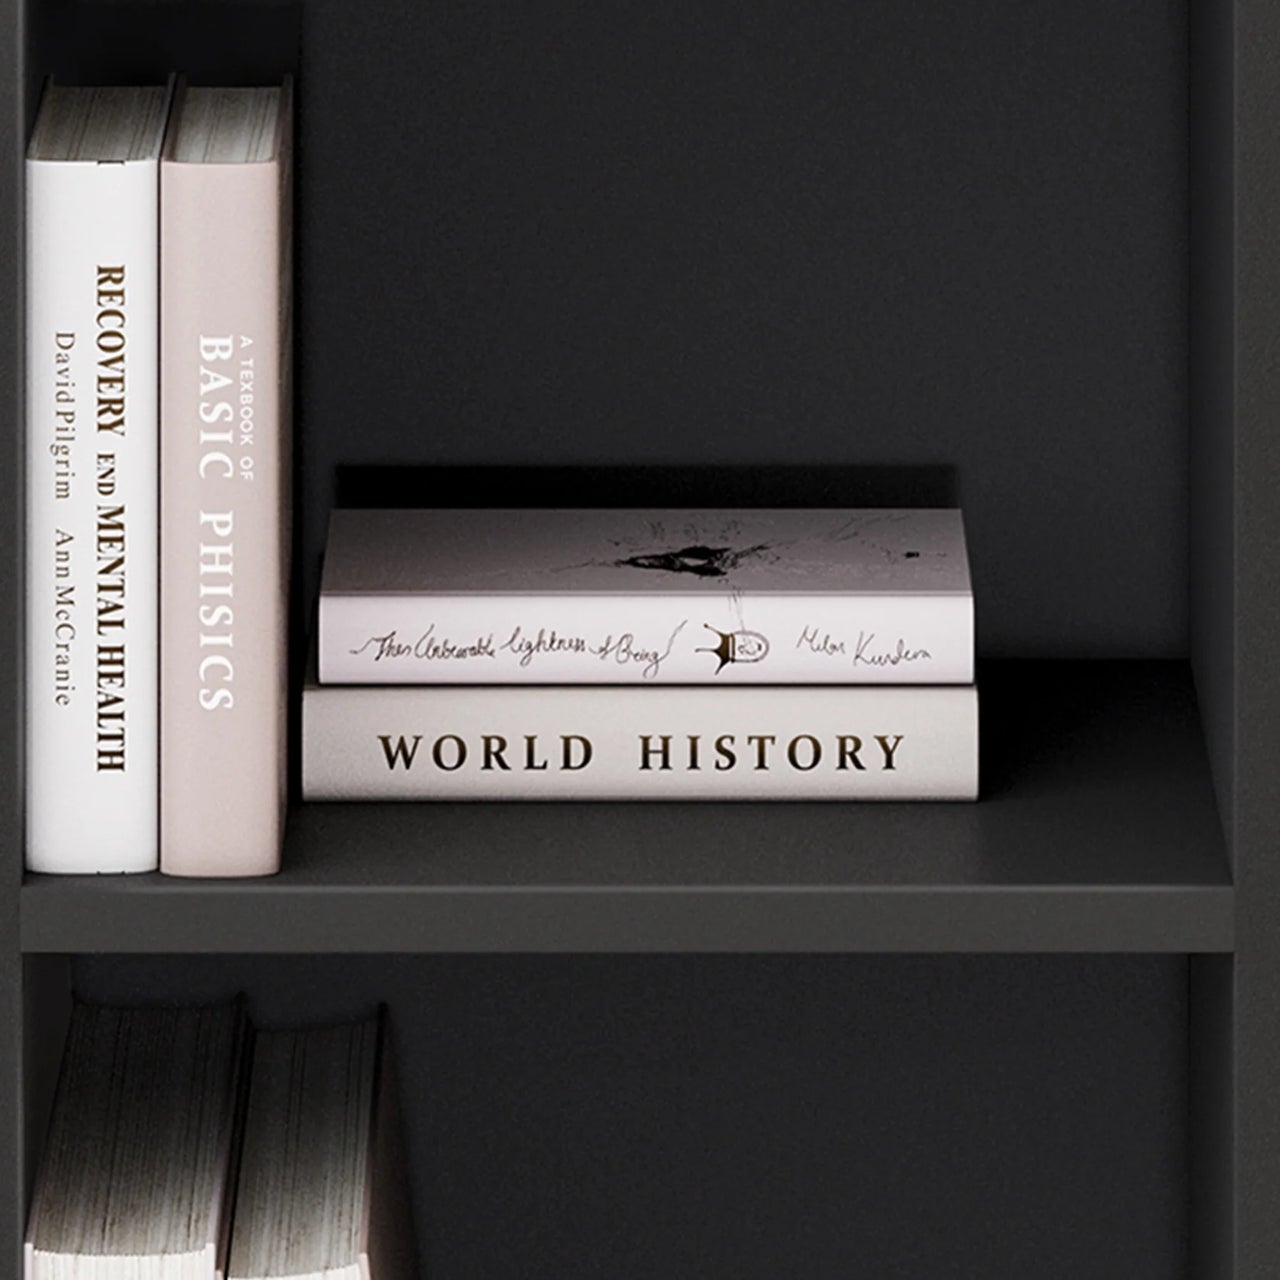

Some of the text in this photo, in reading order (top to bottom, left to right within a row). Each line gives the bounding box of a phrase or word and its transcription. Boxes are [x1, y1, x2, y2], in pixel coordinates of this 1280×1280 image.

[50, 332, 76, 499] David Pilgrim
[239, 335, 254, 481] A TEXBOOK OF
[96, 265, 126, 772] RECOVERY END MENTAL HEALTH
[199, 334, 234, 711] BASIC PHISICS
[55, 528, 76, 706] Ann McCranie
[376, 734, 904, 772] WORLD HISTORY
